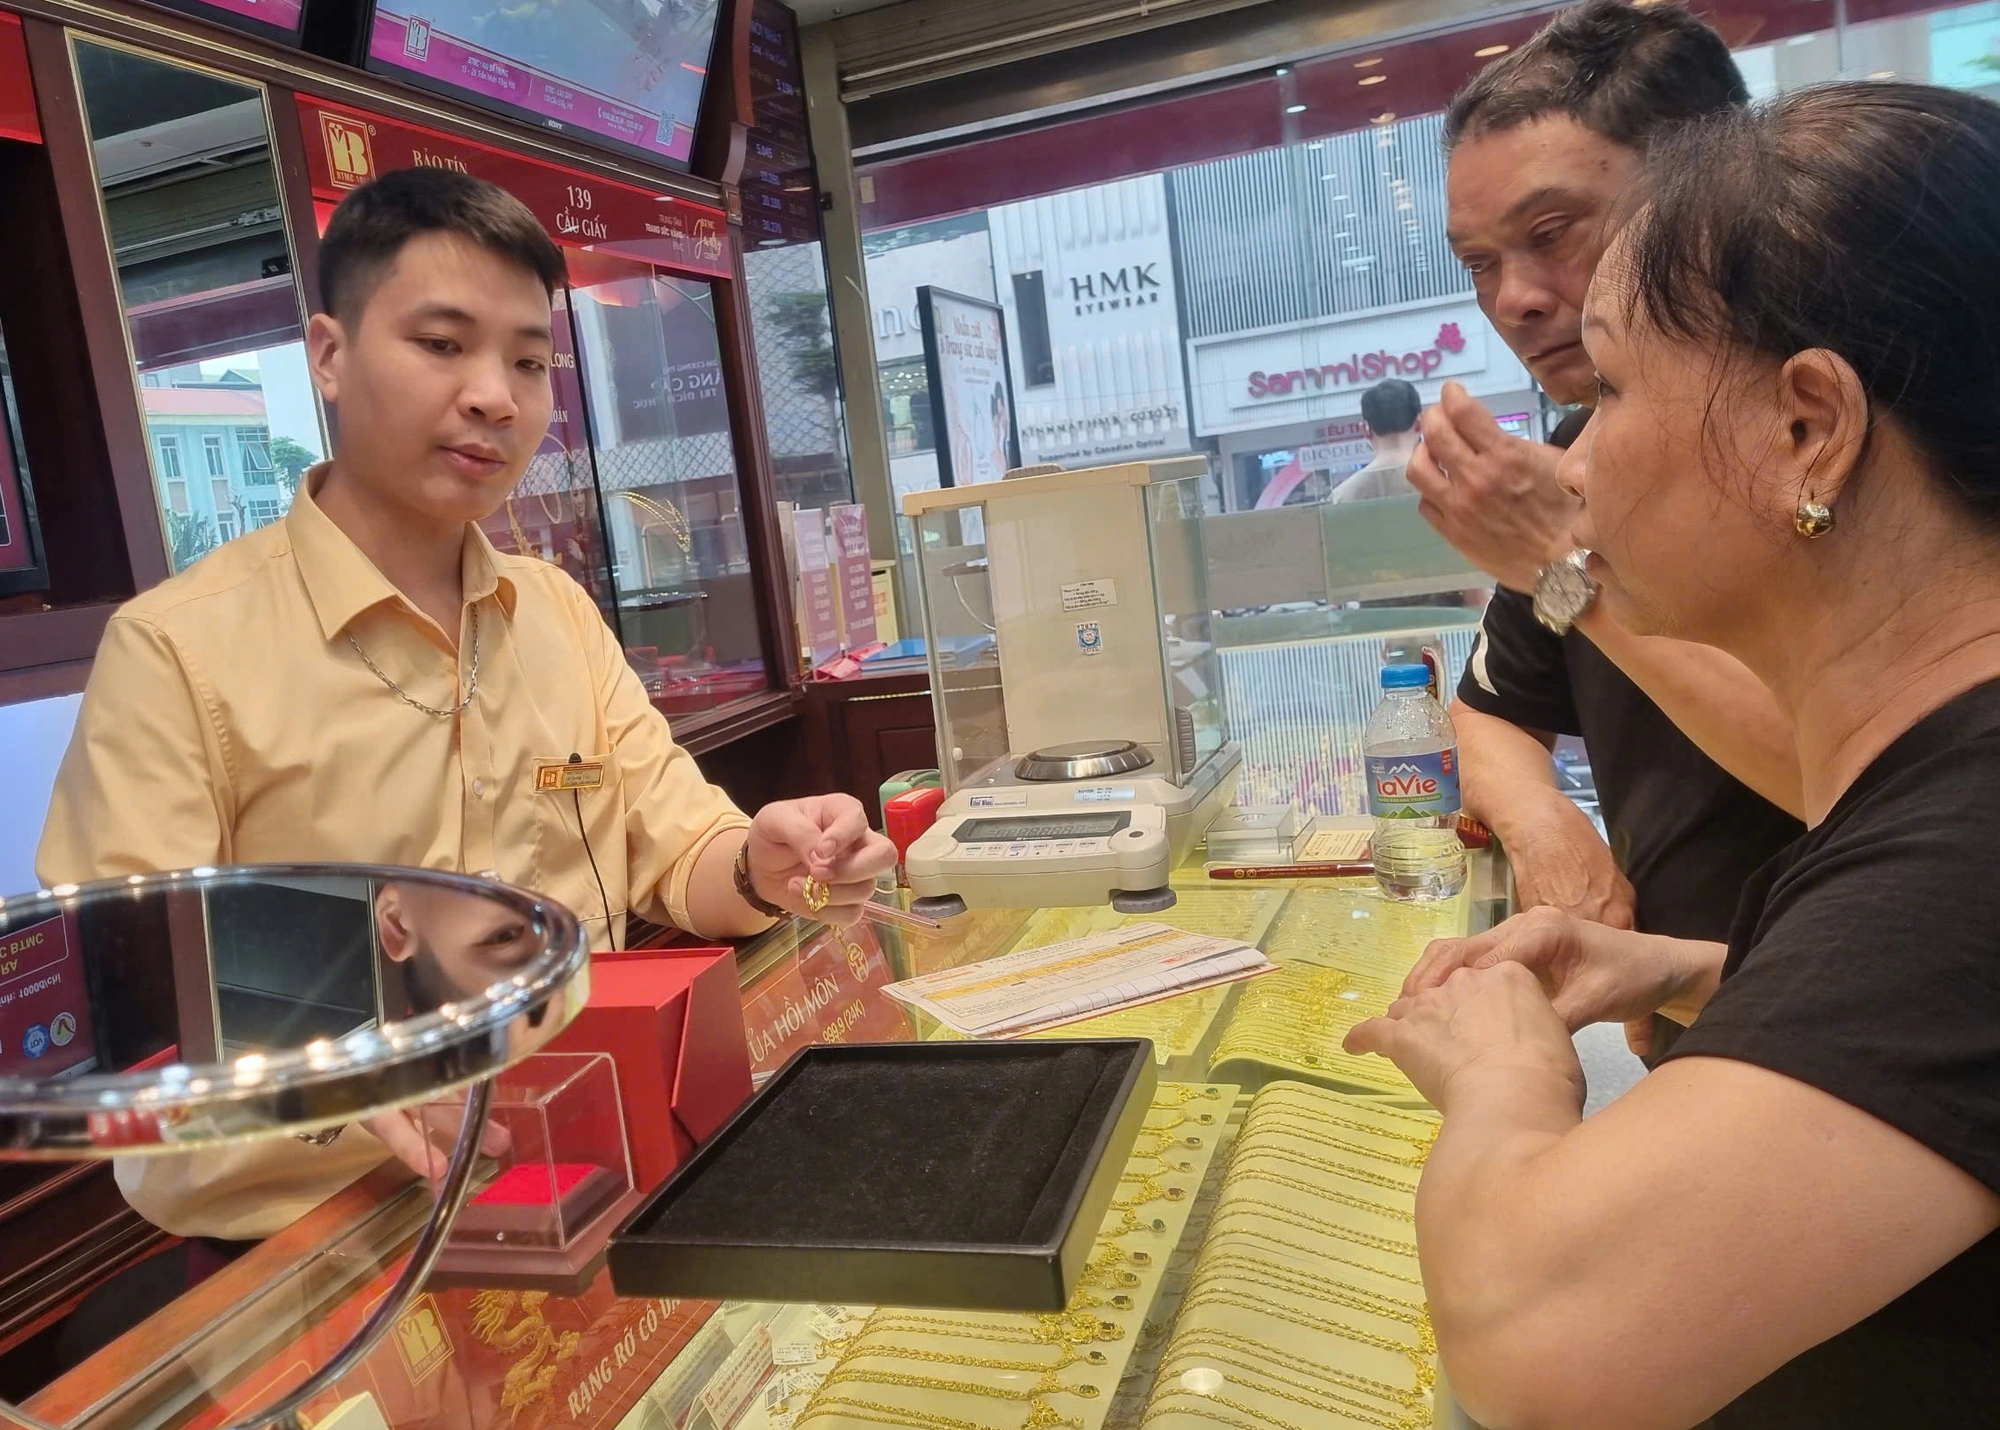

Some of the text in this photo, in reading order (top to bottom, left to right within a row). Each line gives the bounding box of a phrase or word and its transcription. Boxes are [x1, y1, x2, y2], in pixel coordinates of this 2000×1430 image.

[412, 147, 468, 175] BẢO TÍN
[567, 185, 592, 211] 139
[556, 206, 608, 240] CẦU GIẤY
[1069, 262, 1161, 301] HMK
[1075, 292, 1159, 317] EYEWEAR
[550, 352, 575, 369] LONG
[1038, 449, 1080, 463] Supported
[1082, 447, 1092, 458] by
[1095, 440, 1134, 456] Canadian
[1376, 774, 1438, 796] laVie
[748, 973, 840, 1068] ỦA HỒI MÔN
[843, 999, 867, 1032] (24K)
[567, 1357, 613, 1421] RẠNG
[613, 1325, 637, 1370] RỠ
[638, 1304, 658, 1342] CÔ
